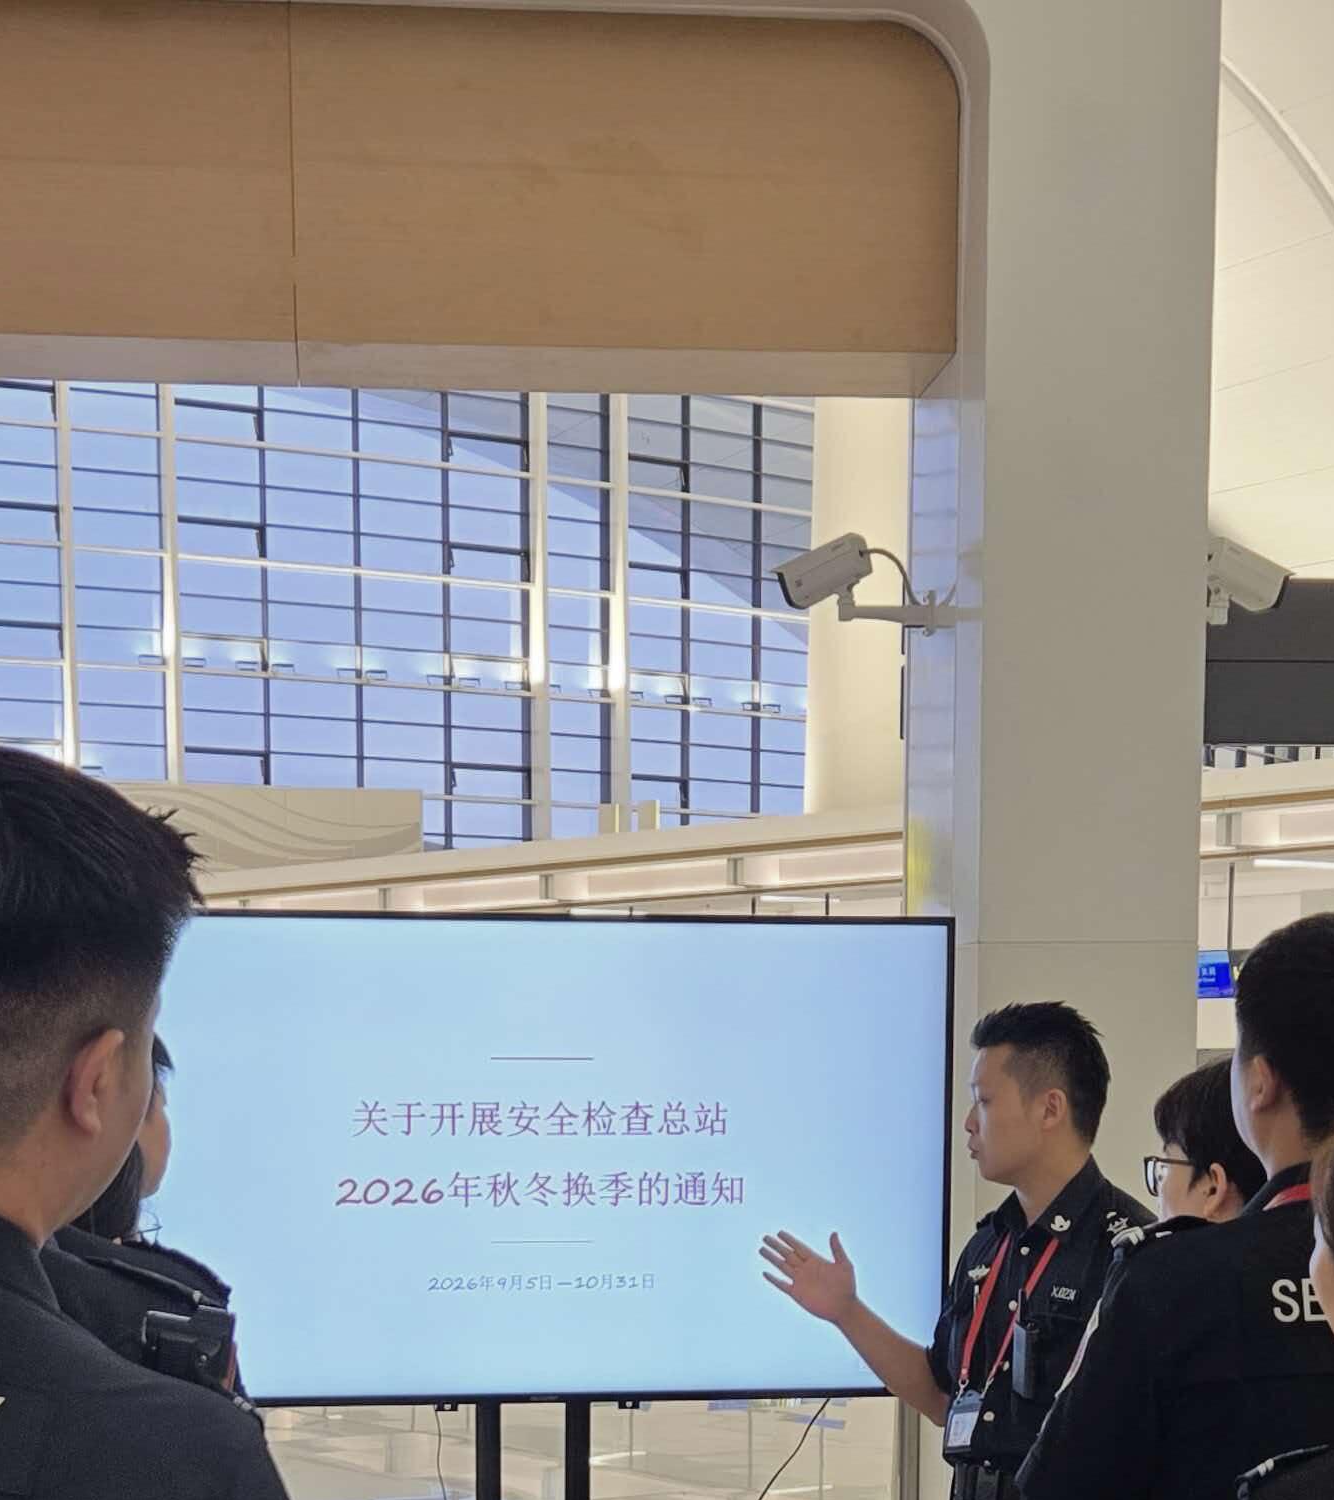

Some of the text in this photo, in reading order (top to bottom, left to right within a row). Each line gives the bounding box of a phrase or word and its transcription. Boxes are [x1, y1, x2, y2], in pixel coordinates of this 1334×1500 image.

[351, 1100, 729, 1138] 关于开展安全检查总站
[335, 1171, 745, 1208] 2026年秋冬换季的通知
